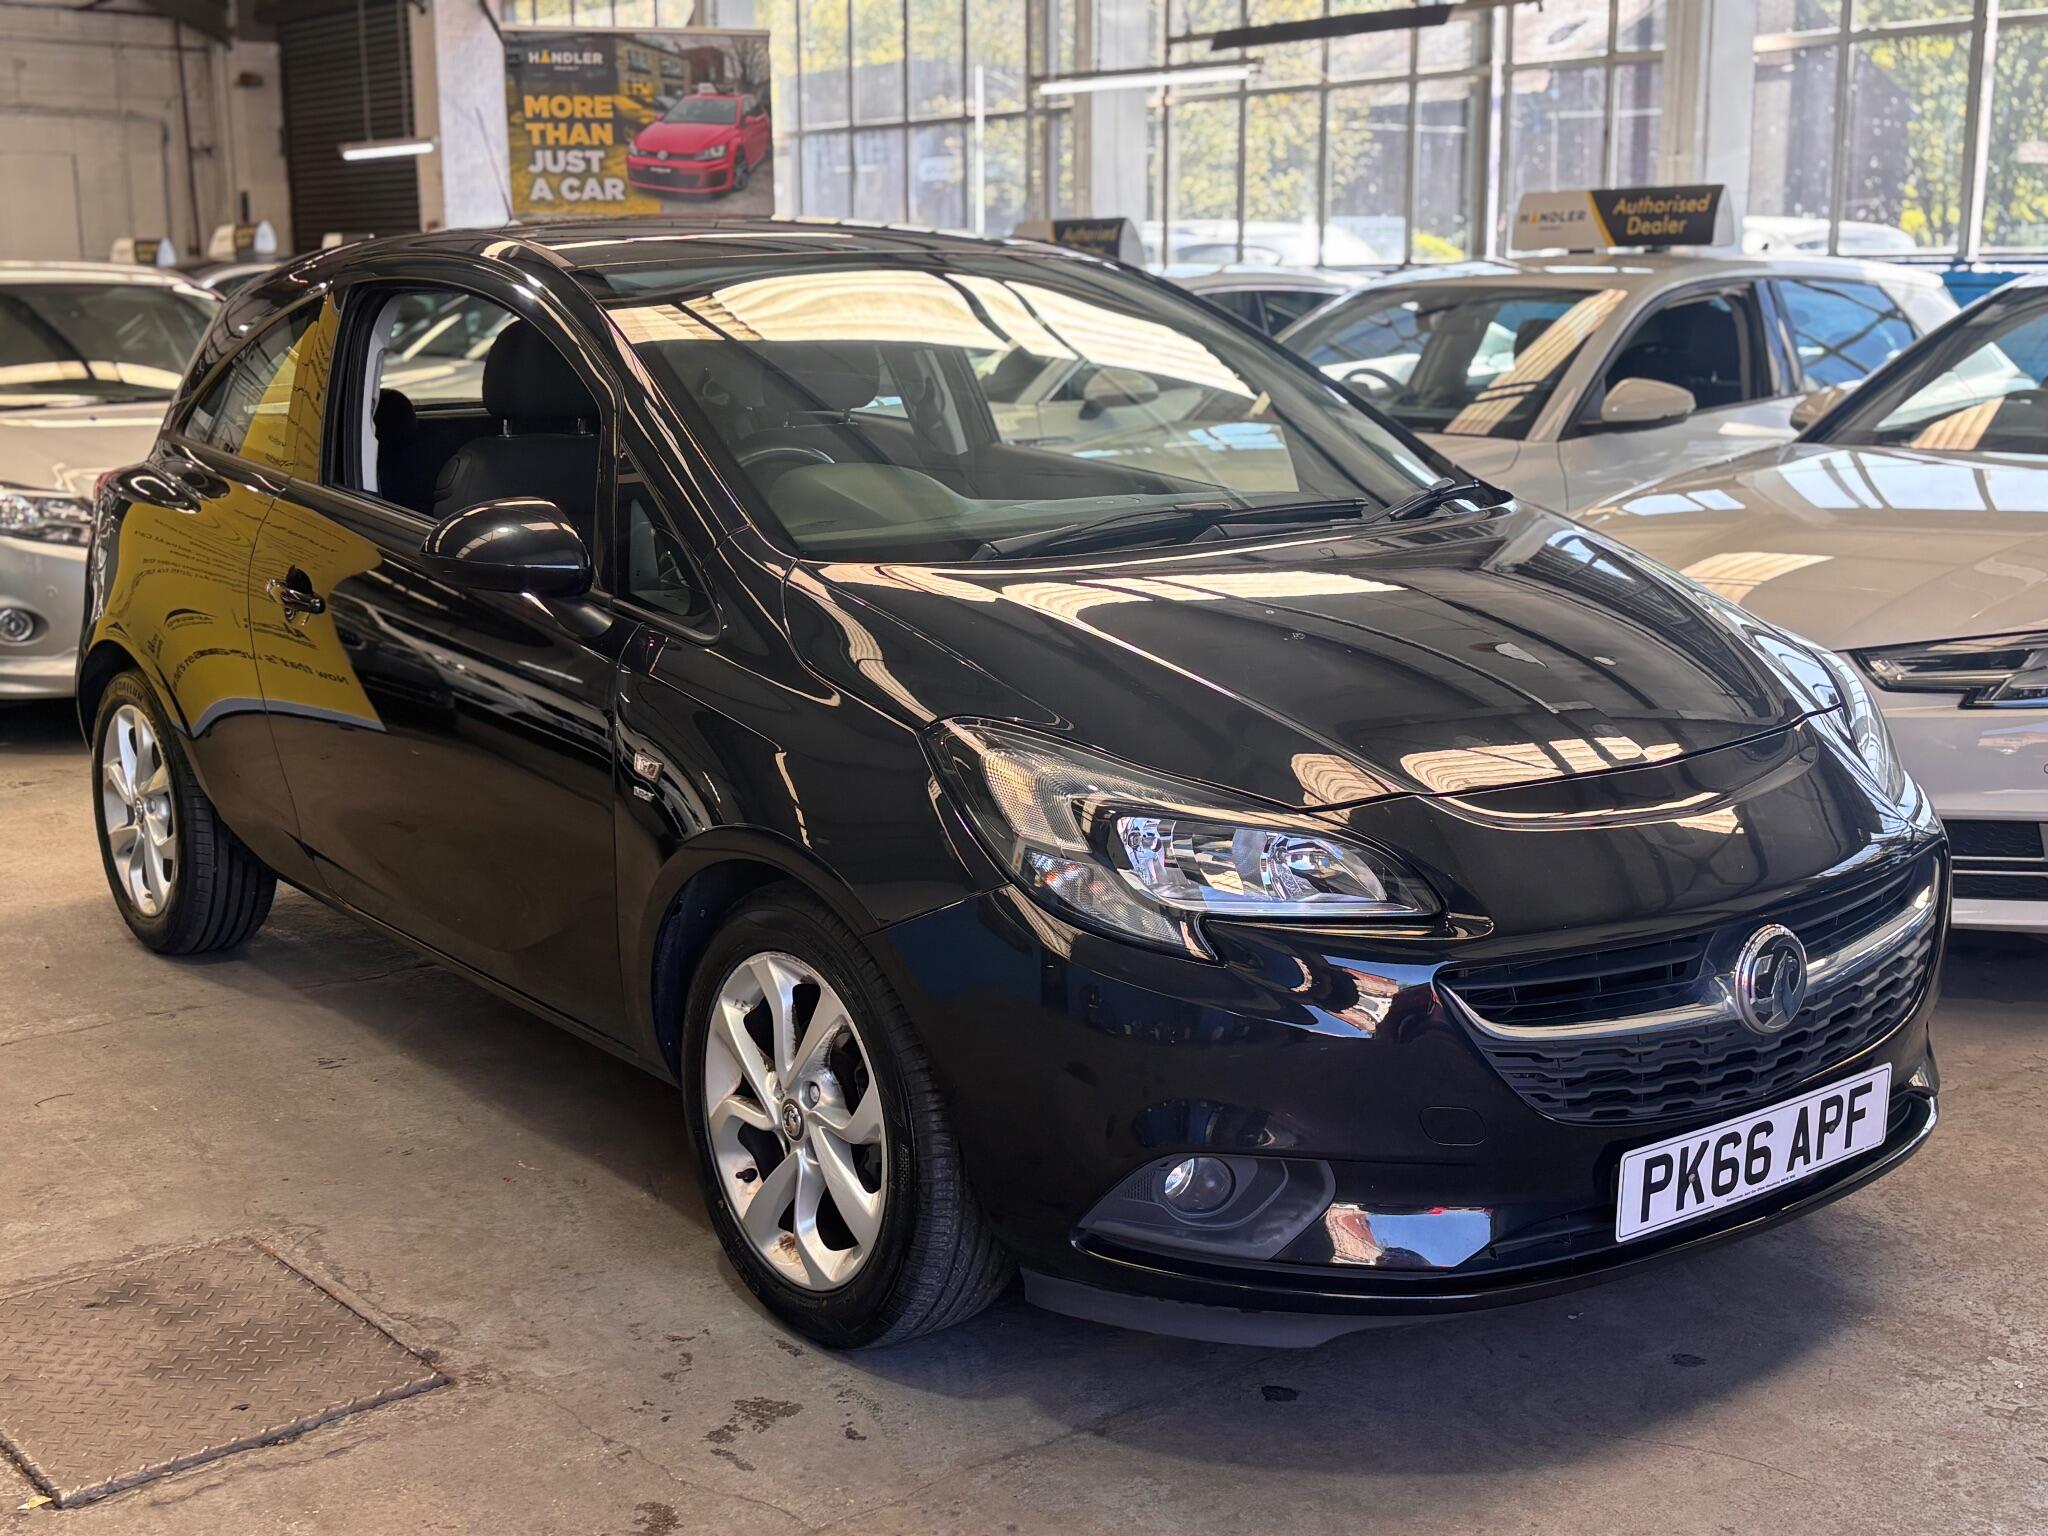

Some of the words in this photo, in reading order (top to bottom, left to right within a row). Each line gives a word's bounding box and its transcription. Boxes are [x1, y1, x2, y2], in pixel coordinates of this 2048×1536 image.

[523, 95, 614, 118] MORE
[525, 122, 613, 145] THAN
[528, 150, 604, 173] JUST
[530, 178, 553, 200] A
[560, 178, 625, 200] CAR
[1612, 193, 1712, 216] Authorised
[1626, 216, 1688, 236] Dealer
[1640, 1120, 1774, 1223] PK66
[1786, 1081, 1873, 1173] APF
